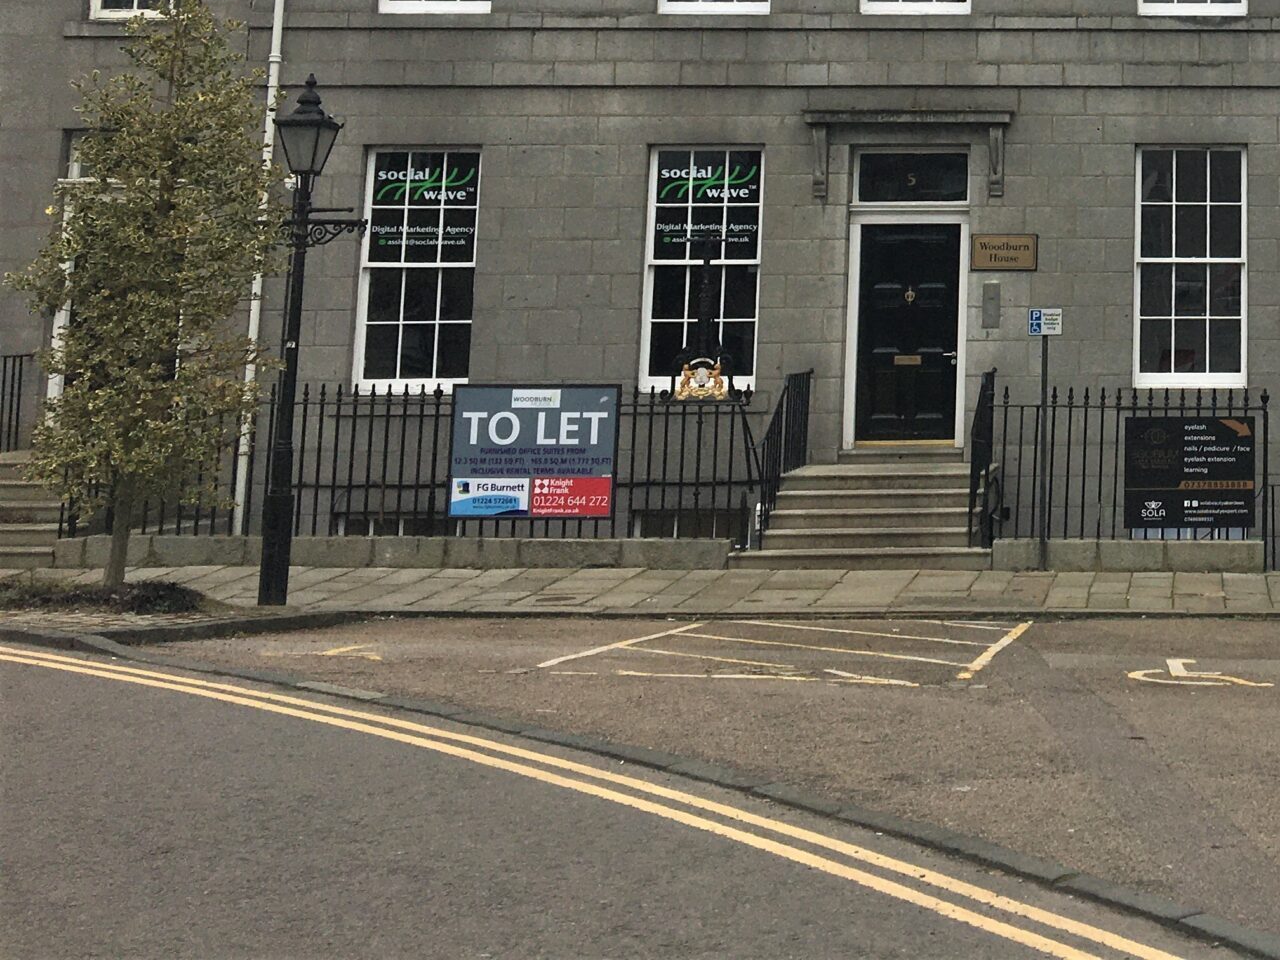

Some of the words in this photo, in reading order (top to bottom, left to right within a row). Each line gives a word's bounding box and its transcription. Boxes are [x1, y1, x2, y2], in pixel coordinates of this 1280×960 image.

[377, 167, 430, 180] social
[661, 165, 712, 178] social
[423, 190, 467, 200] wave
[706, 188, 749, 198] wave
[372, 225, 397, 234] Digital
[445, 225, 475, 234] Agency
[656, 223, 681, 232] Digital
[728, 223, 757, 232] Agency
[979, 241, 1030, 251] Woodburn
[989, 253, 1019, 262] House
[462, 411, 520, 445] TO
[536, 411, 608, 445] LET
[1183, 466, 1208, 474] learning
[476, 483, 489, 492] FG
[490, 483, 524, 492] Burnett
[549, 478, 573, 488] Knight
[533, 496, 565, 506] 01224
[567, 496, 586, 506] 644
[588, 496, 608, 506] 272
[1141, 509, 1166, 517] SOLA
